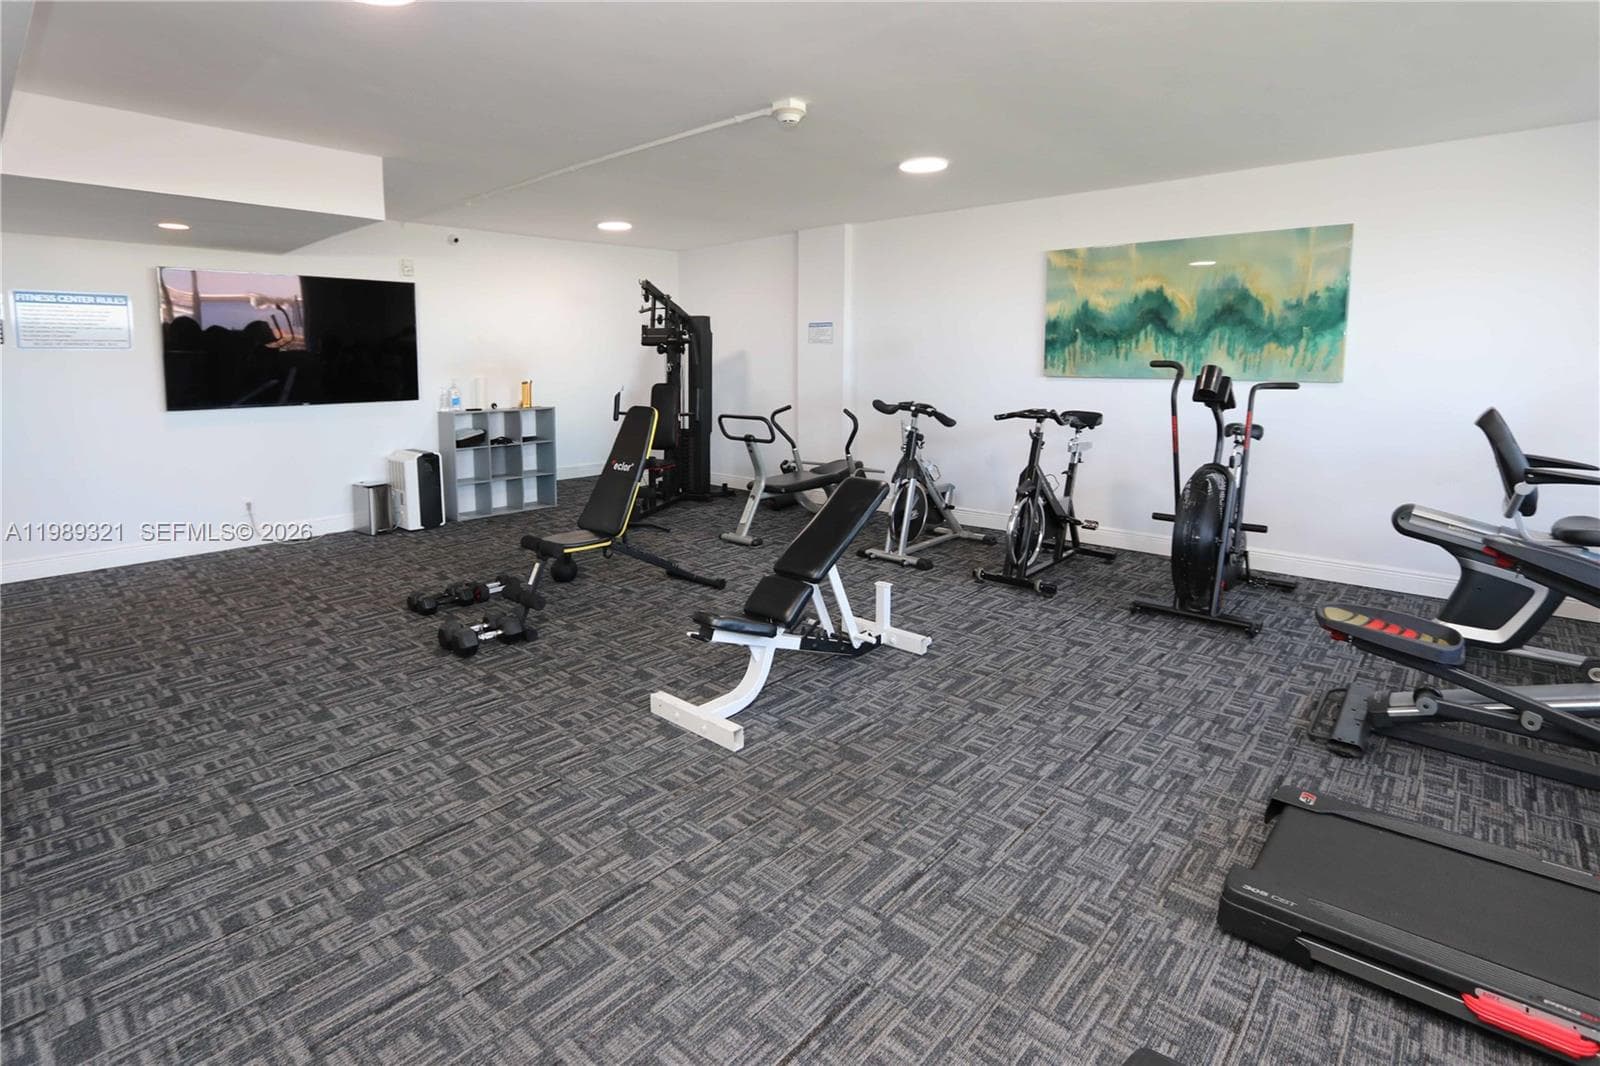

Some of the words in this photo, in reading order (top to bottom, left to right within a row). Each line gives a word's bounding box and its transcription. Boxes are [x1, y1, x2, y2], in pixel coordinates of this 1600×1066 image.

[16, 293, 56, 302] FITNESS
[57, 294, 95, 303] CENTER
[96, 295, 126, 304] RULES
